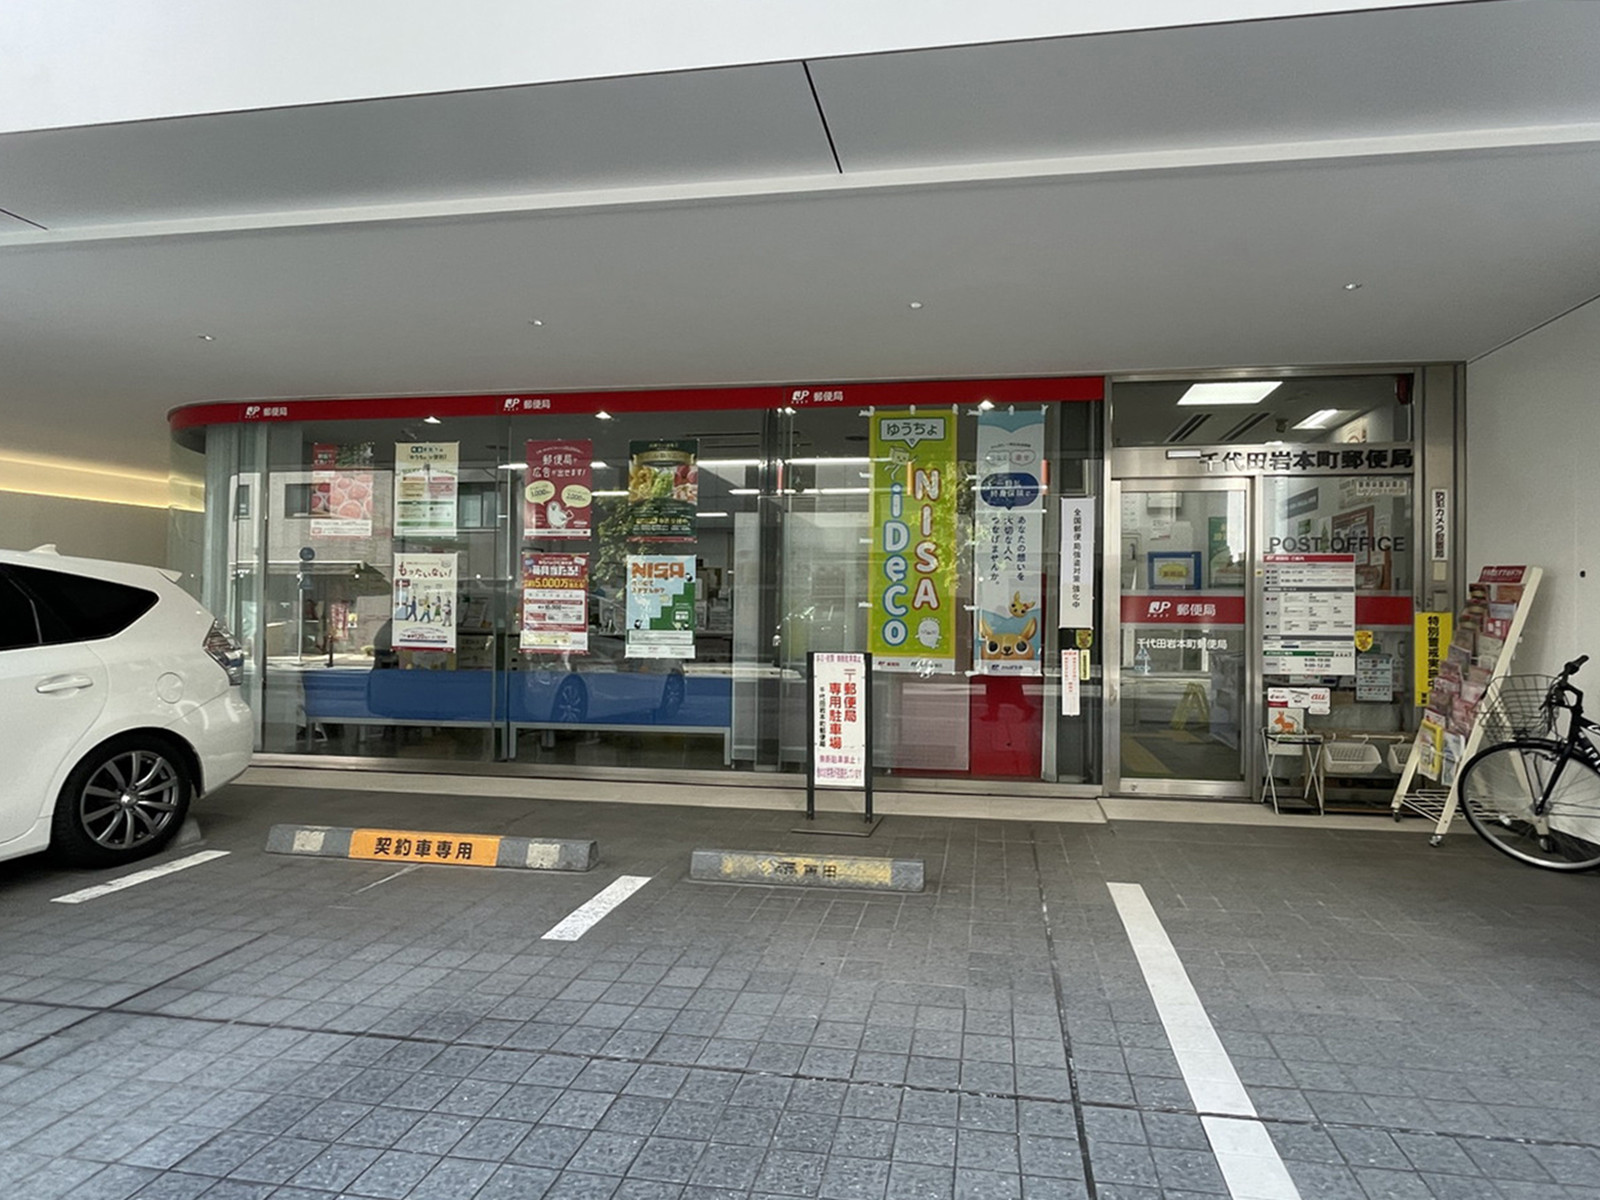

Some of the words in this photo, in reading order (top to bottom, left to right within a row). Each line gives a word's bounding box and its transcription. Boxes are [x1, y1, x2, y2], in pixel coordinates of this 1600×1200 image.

[523, 399, 550, 410] 郵便局
[813, 391, 843, 402] 郵便局
[263, 407, 287, 417] 郵便局
[886, 423, 937, 436] ゆうちょ
[1199, 447, 1414, 472] 千代田岩本町郵便局
[914, 467, 941, 610] NISA
[1003, 515, 1014, 563] 大切な人へ
[1270, 536, 1322, 553] POST
[1330, 536, 1405, 552] OFFICE
[1016, 515, 1027, 582] あなたの想いを
[631, 562, 685, 579] NISA
[882, 482, 909, 646] iDeCo
[1176, 603, 1216, 617] 郵便局
[1137, 638, 1228, 650] 千代田岩本町郵便局
[828, 682, 843, 750] 専用駐車場
[373, 836, 474, 861] 契約車専用
